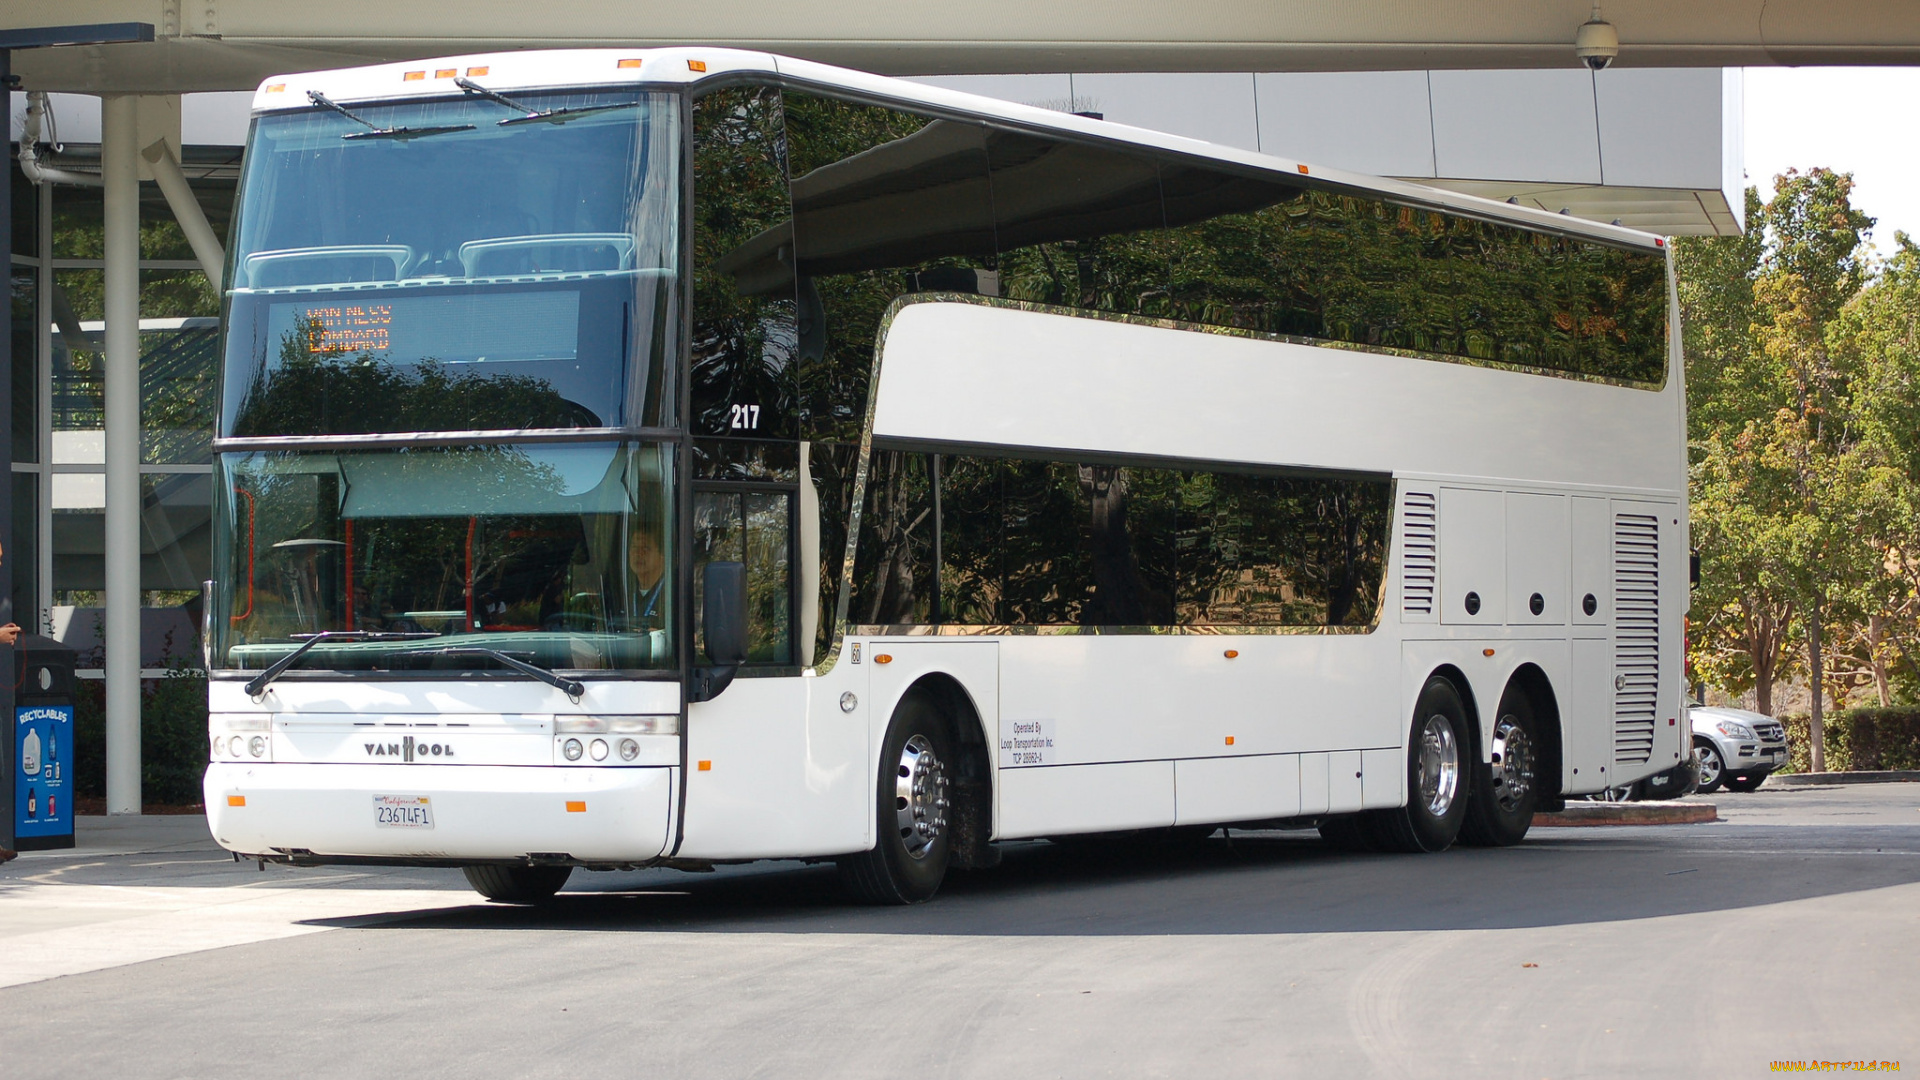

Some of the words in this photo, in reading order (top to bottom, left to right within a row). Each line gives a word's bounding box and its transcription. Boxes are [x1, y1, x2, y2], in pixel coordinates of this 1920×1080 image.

[731, 403, 760, 429] 217
[19, 708, 68, 725] RECYCLABLES
[1014, 722, 1034, 735] Operated
[1035, 721, 1041, 735] By
[1001, 738, 1012, 751] Loop
[1014, 737, 1045, 750] Transportation
[384, 796, 418, 807] California
[378, 806, 429, 824] 23674F1
